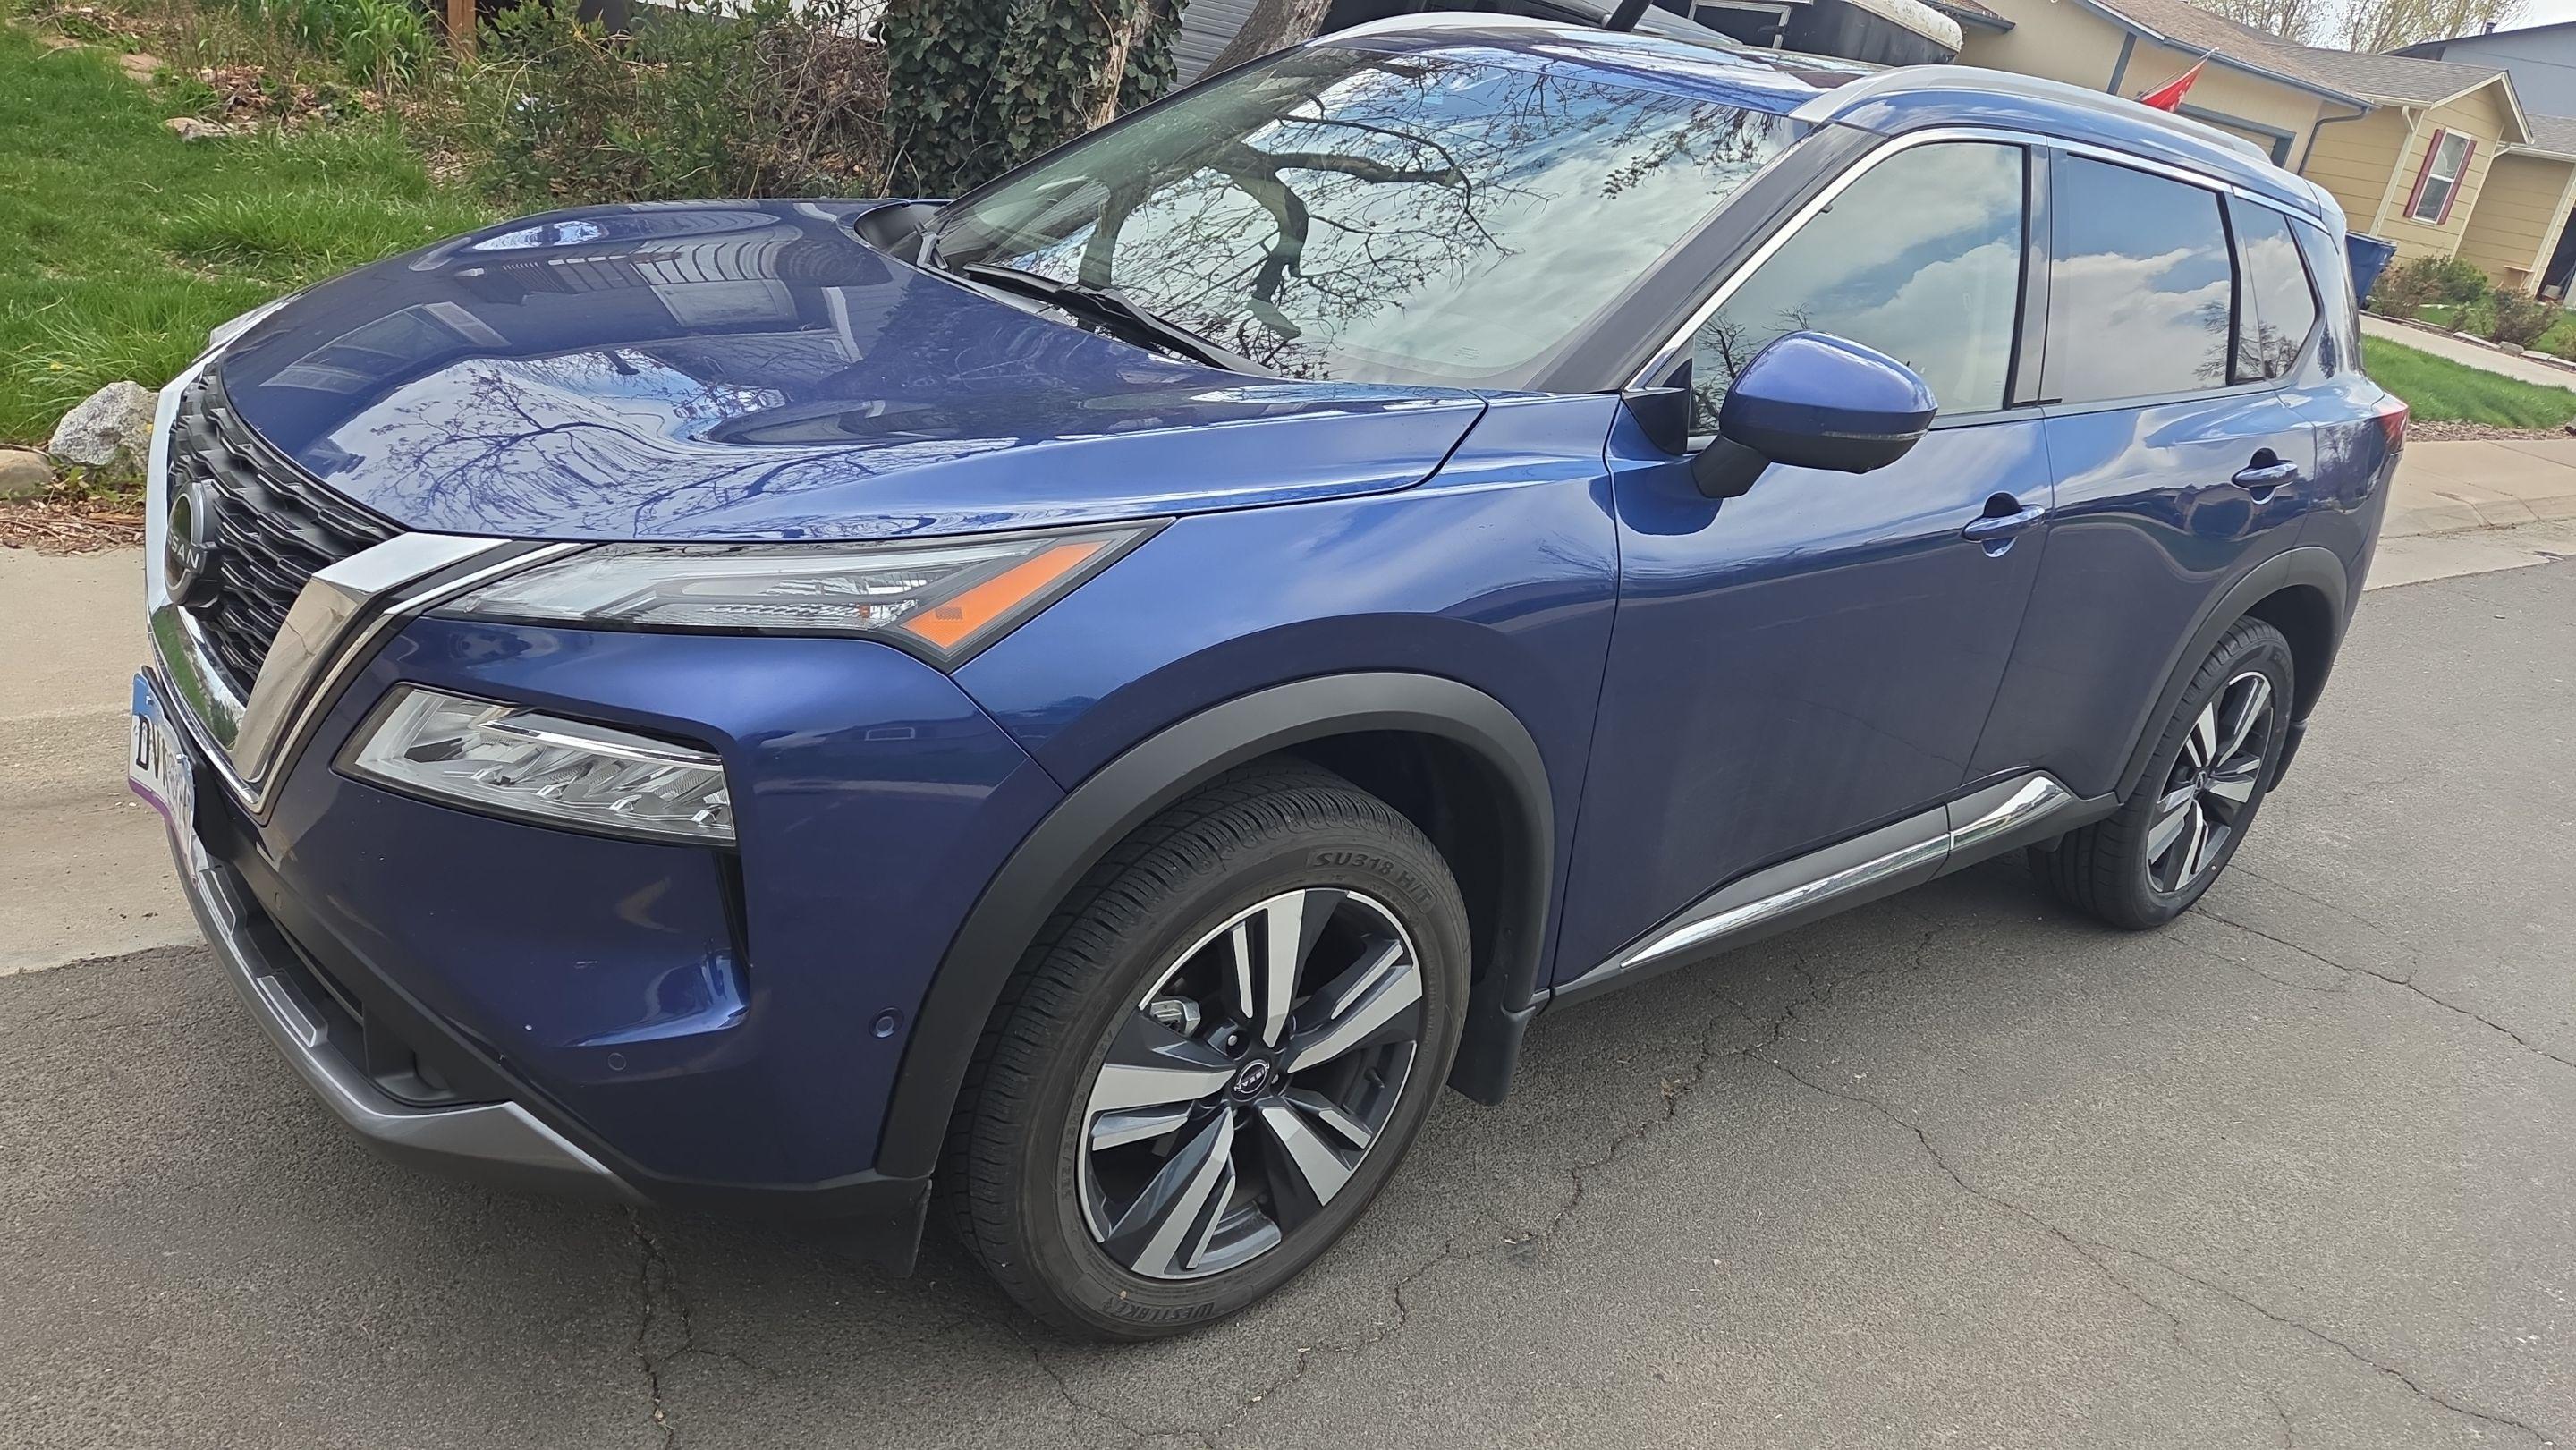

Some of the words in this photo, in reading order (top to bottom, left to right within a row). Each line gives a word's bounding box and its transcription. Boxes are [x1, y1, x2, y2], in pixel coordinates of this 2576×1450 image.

[1313, 852, 1394, 875] SU318
[1395, 870, 1433, 906] H/T
[1114, 1302, 1216, 1322] WESTLAKE
